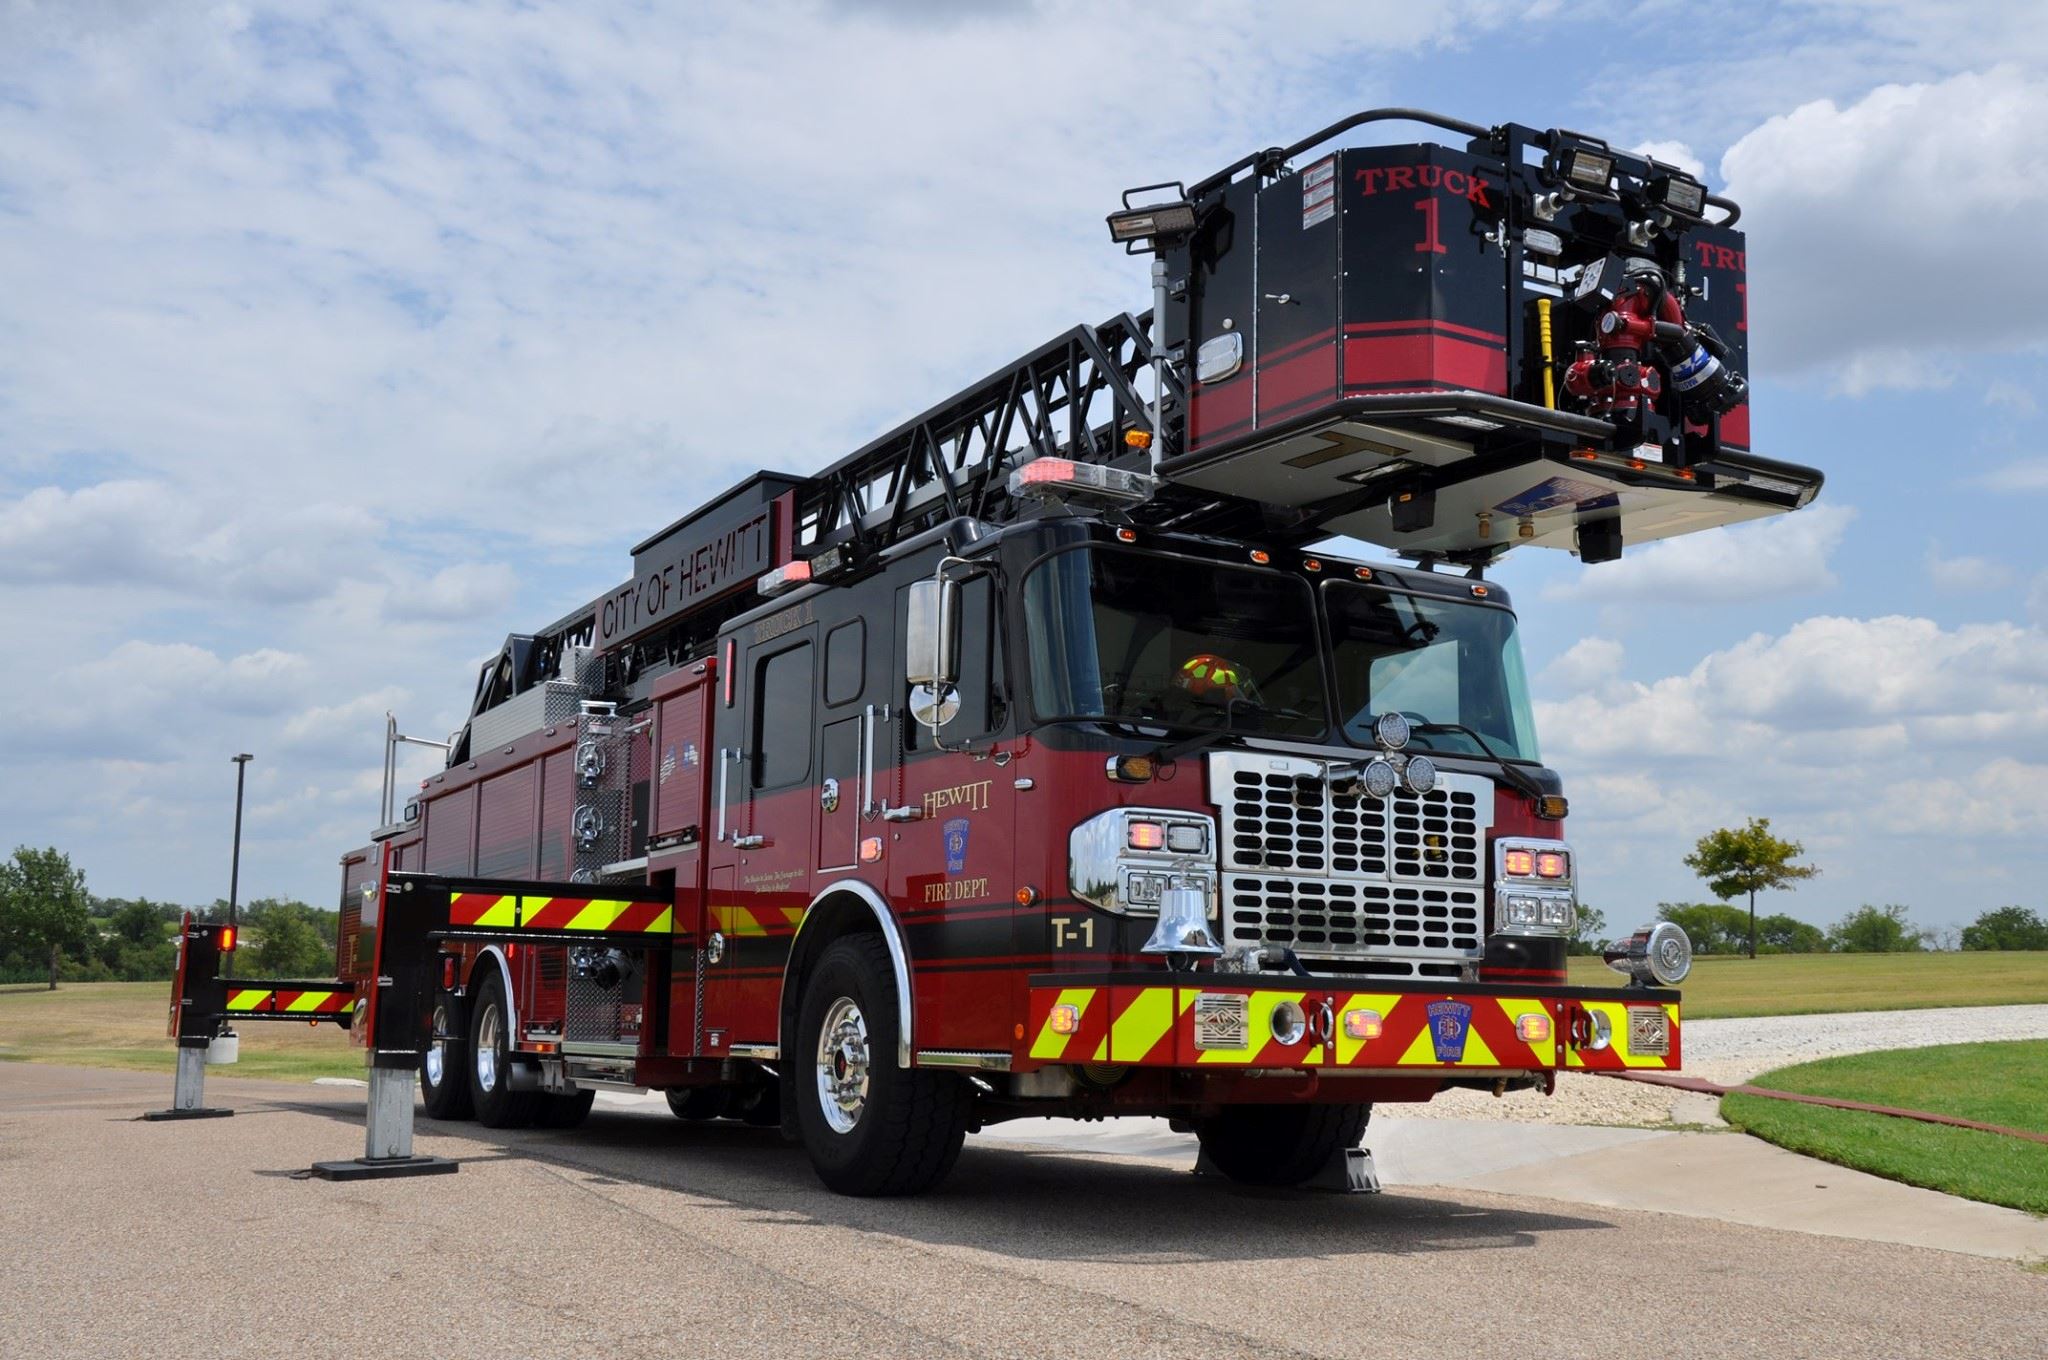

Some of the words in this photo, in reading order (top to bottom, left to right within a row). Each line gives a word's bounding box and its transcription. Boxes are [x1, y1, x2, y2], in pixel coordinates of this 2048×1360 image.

[1355, 165, 1491, 209] TRUCK
[1414, 197, 1448, 254] 1
[602, 581, 643, 639] CITY
[647, 564, 675, 616] OF
[679, 513, 767, 602] HEWITT
[922, 780, 993, 819] HEWITT
[924, 881, 952, 903] FIRE
[955, 878, 990, 900] DEPT.
[1051, 918, 1093, 948] T-1
